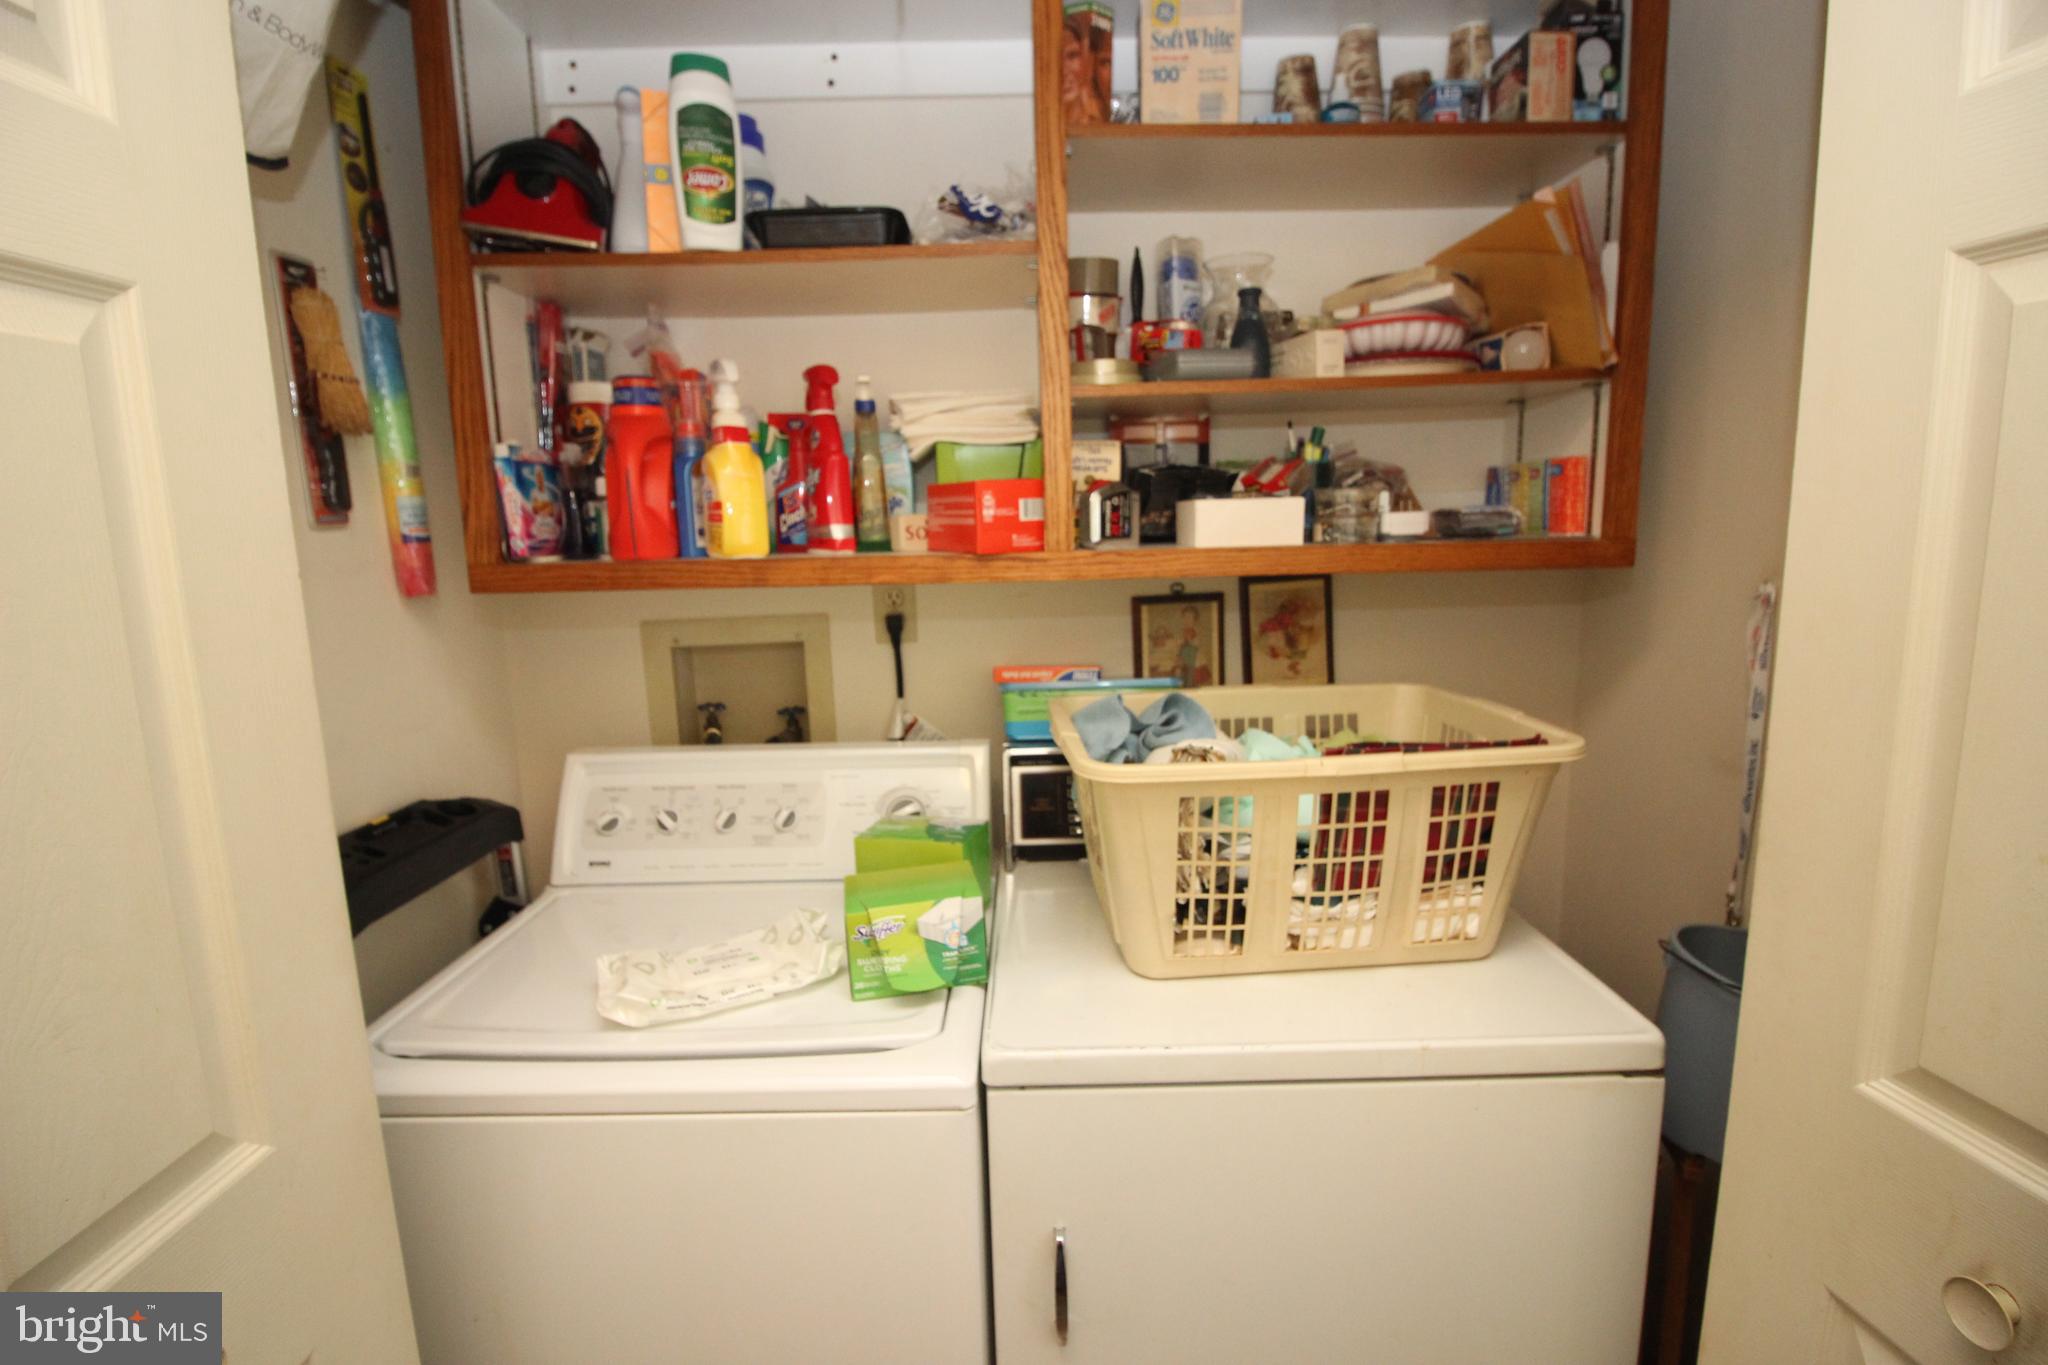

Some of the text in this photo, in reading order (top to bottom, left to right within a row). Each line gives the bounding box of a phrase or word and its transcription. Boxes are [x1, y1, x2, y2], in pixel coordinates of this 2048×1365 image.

[1151, 26, 1235, 48] Soft White
[1152, 65, 1180, 83] 100
[686, 168, 729, 190] Comet
[853, 919, 905, 941] Swiffer
